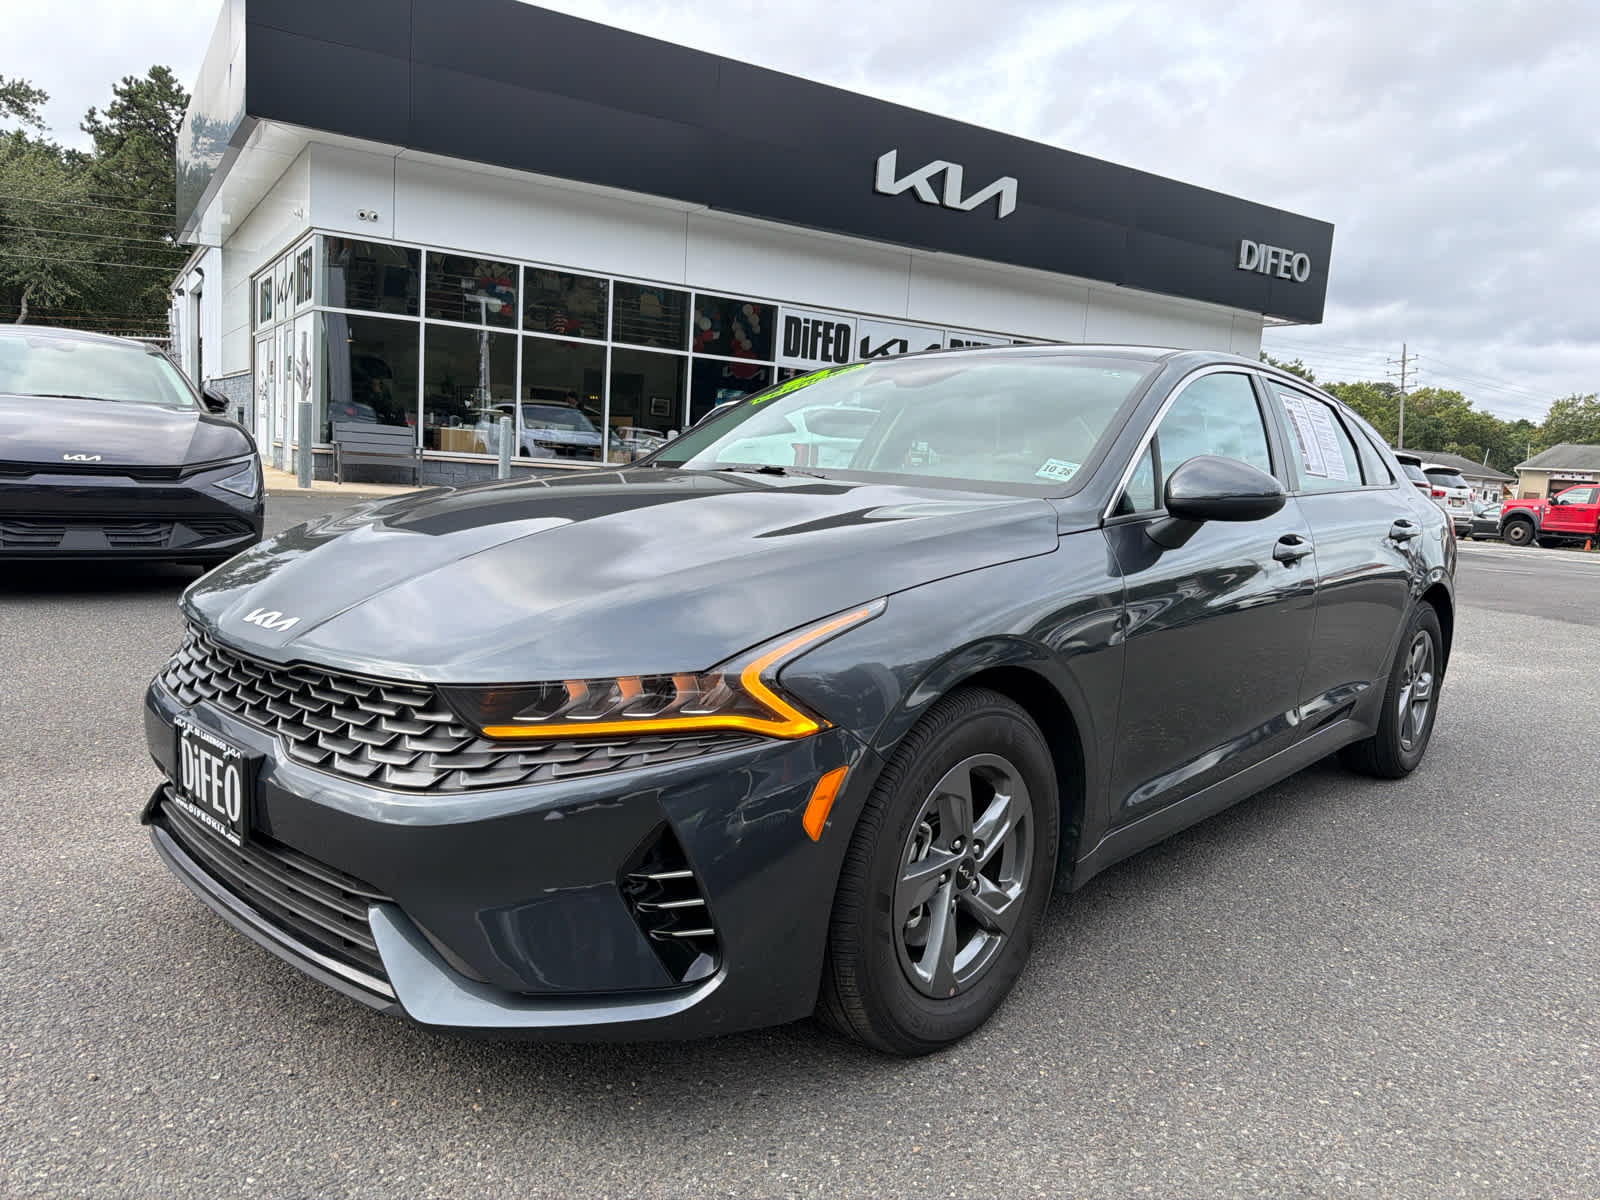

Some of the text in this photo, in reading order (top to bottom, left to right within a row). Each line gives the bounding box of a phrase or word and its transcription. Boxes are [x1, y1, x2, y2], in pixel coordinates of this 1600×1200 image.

[876, 149, 1018, 219] KIA
[1239, 239, 1311, 282] DIFEO
[782, 315, 851, 365] DiFEO
[63, 453, 102, 462] KIA
[242, 607, 302, 632] KIA
[180, 736, 241, 822] DiFEO
